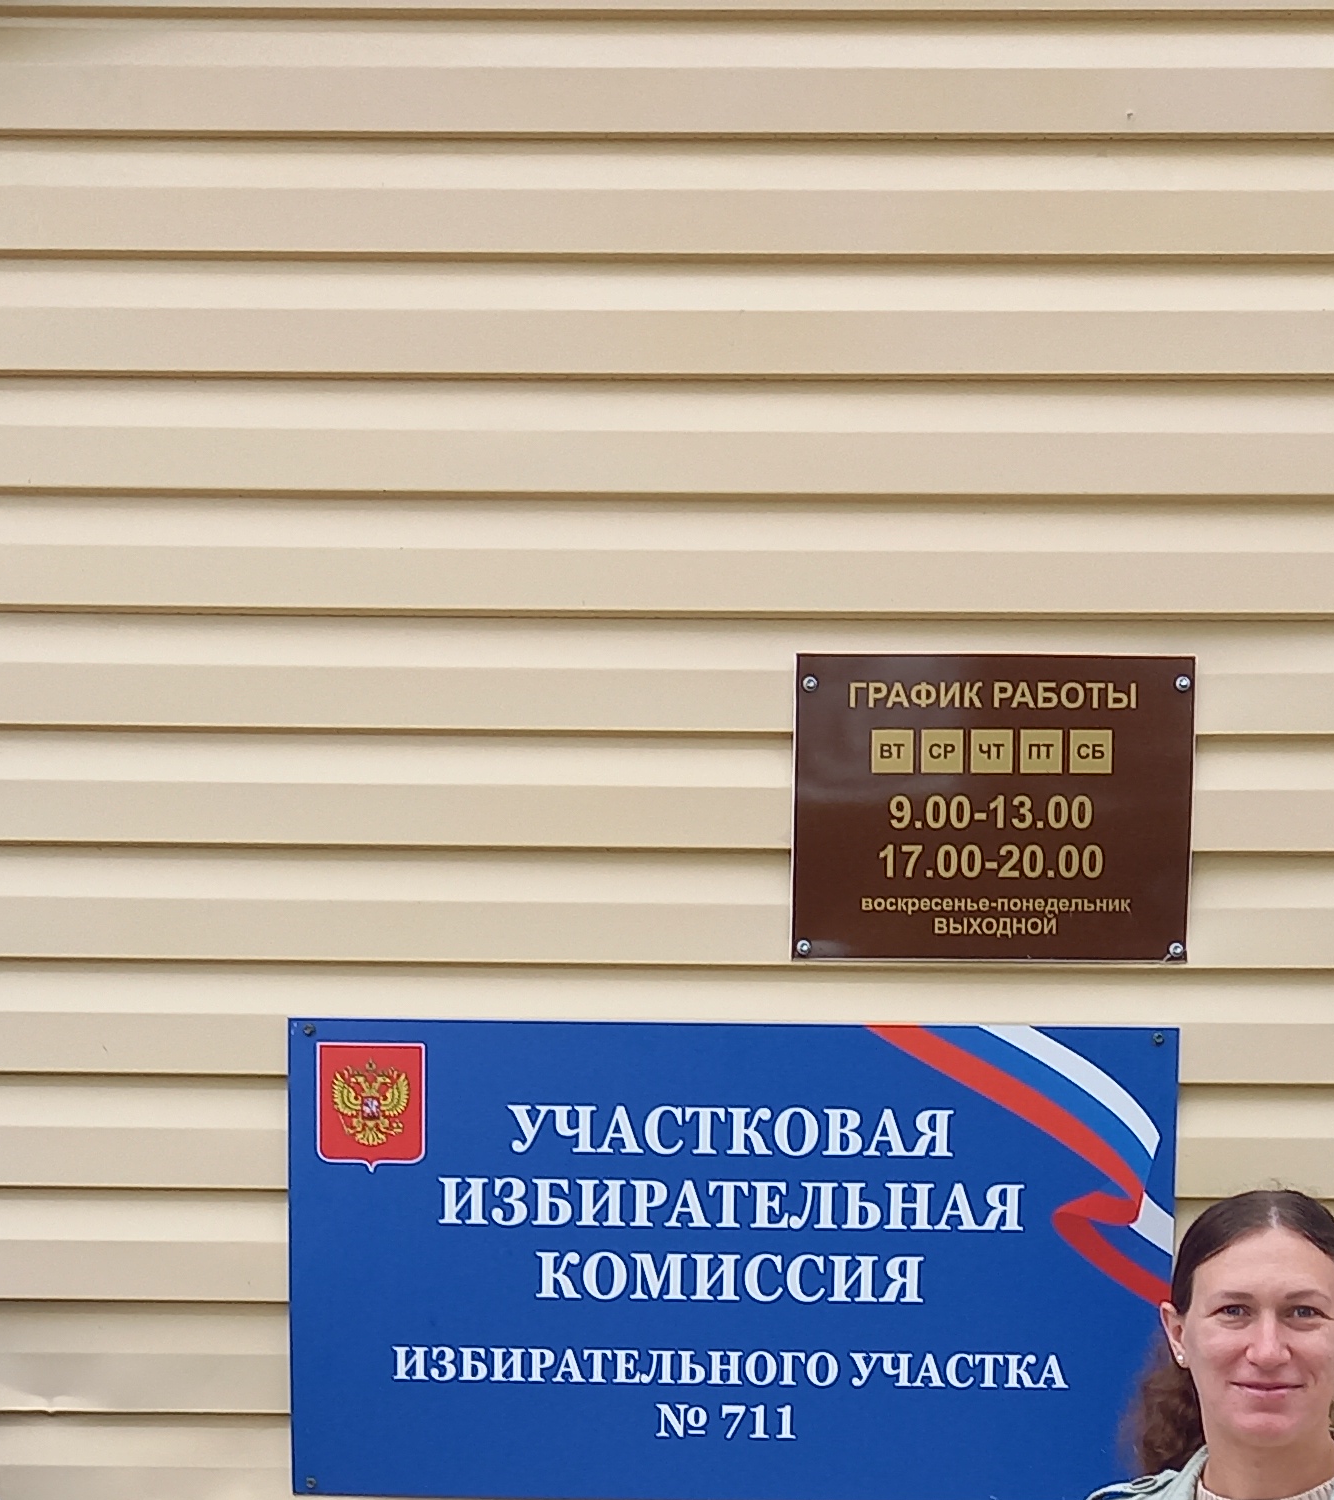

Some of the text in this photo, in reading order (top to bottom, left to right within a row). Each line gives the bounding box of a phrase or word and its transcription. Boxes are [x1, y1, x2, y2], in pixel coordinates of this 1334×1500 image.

[850, 682, 1136, 708] ГРАФИК РАБОТЫ
[881, 744, 1104, 759] ВТ СР ЧТ ПТ СБ
[890, 796, 1091, 828] 9.00-13.00
[880, 845, 1102, 877] 17.00-20.00
[862, 898, 1129, 914] воскресенье-понедельник
[935, 915, 1056, 937] ВЫХОДНОЙ
[508, 1105, 953, 1156] УЧАСТКОВАЯ
[439, 1178, 1024, 1230] ИЗБИРАТЕЛЬНАЯ
[536, 1252, 923, 1302] КОМИССИЯ
[394, 1347, 1067, 1388] ИЗБИРАТЕЛЬНОГО УЧАСТКА
[657, 1404, 795, 1438] № 711
